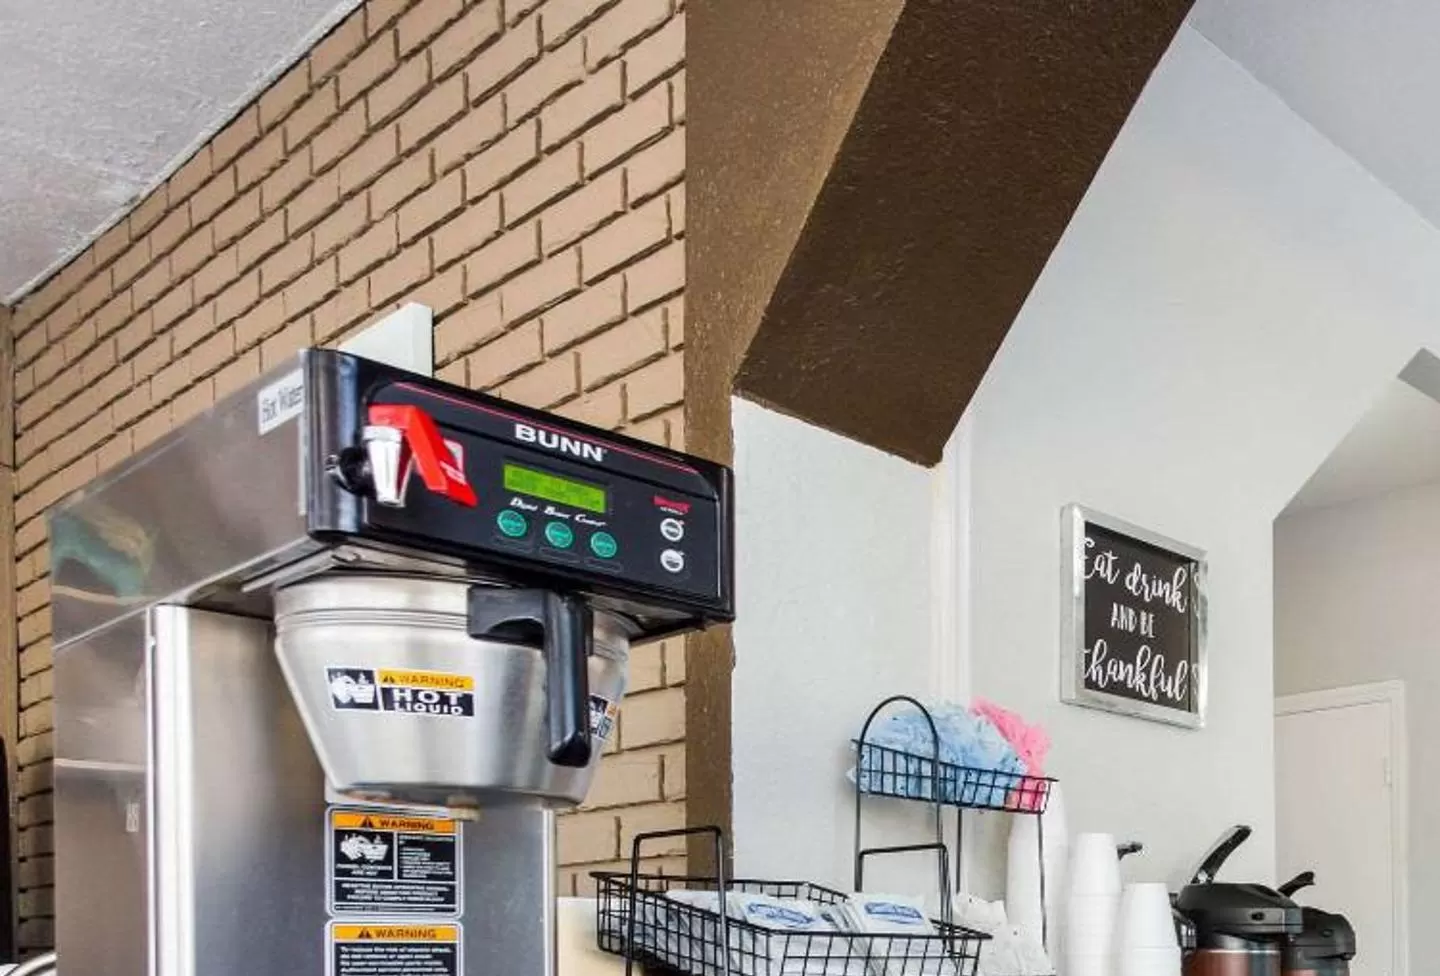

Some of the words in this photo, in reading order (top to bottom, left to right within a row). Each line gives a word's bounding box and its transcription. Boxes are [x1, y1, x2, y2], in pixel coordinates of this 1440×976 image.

[514, 423, 603, 462] BUNN
[1125, 562, 1188, 614] drink
[1111, 602, 1137, 632] AND
[1140, 608, 1156, 638] BE
[399, 675, 465, 688] WARNING
[392, 688, 464, 705] HOT
[393, 702, 464, 716] LIQUID
[379, 819, 435, 830] WARNING
[374, 928, 437, 938] WARNING
